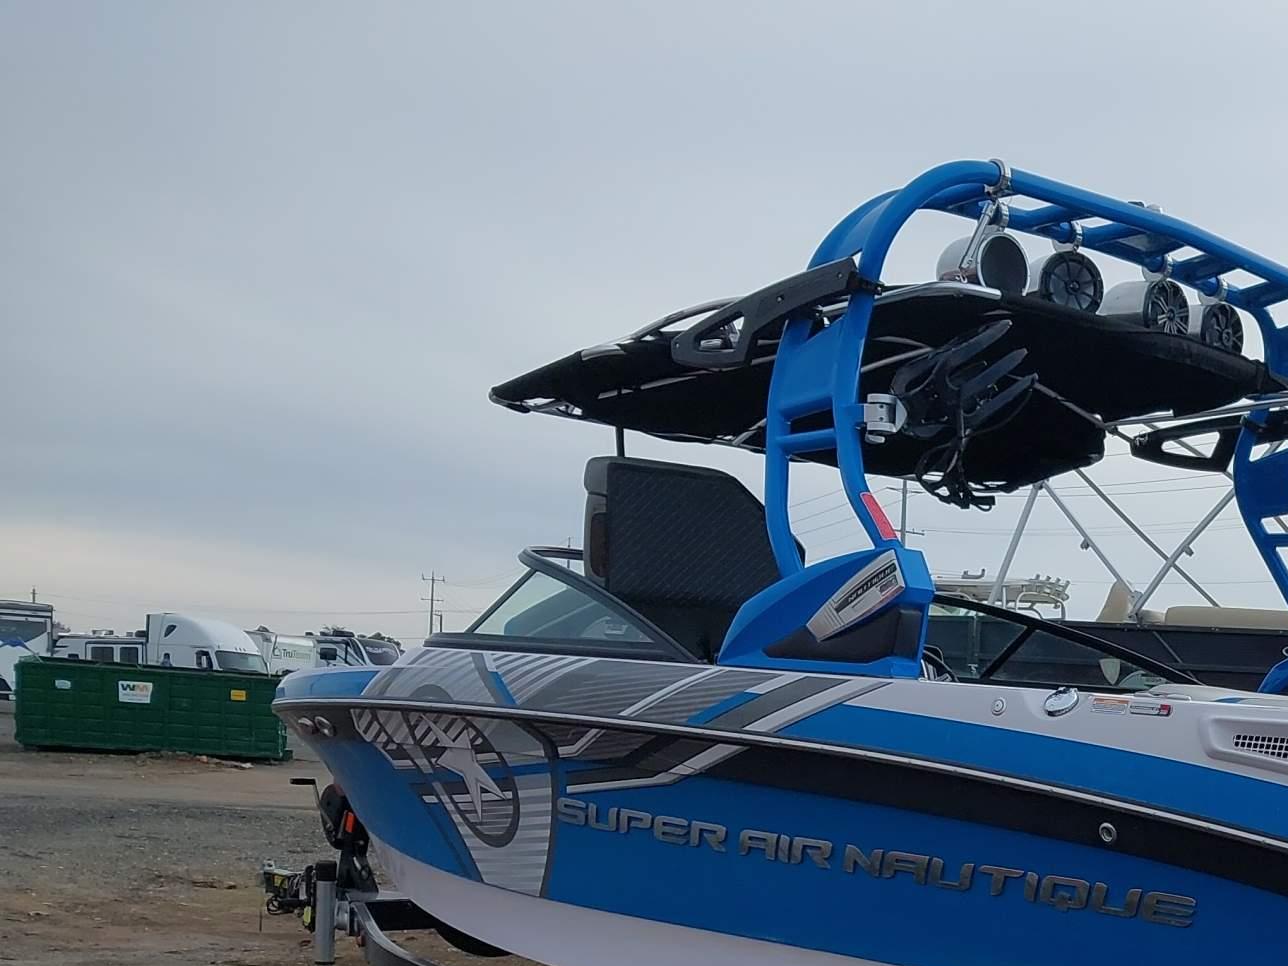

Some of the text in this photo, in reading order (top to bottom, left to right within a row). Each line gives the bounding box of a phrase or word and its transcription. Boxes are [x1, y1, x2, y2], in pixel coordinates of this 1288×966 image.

[557, 797, 1197, 929] SUPER AIR NAUTIQUE
